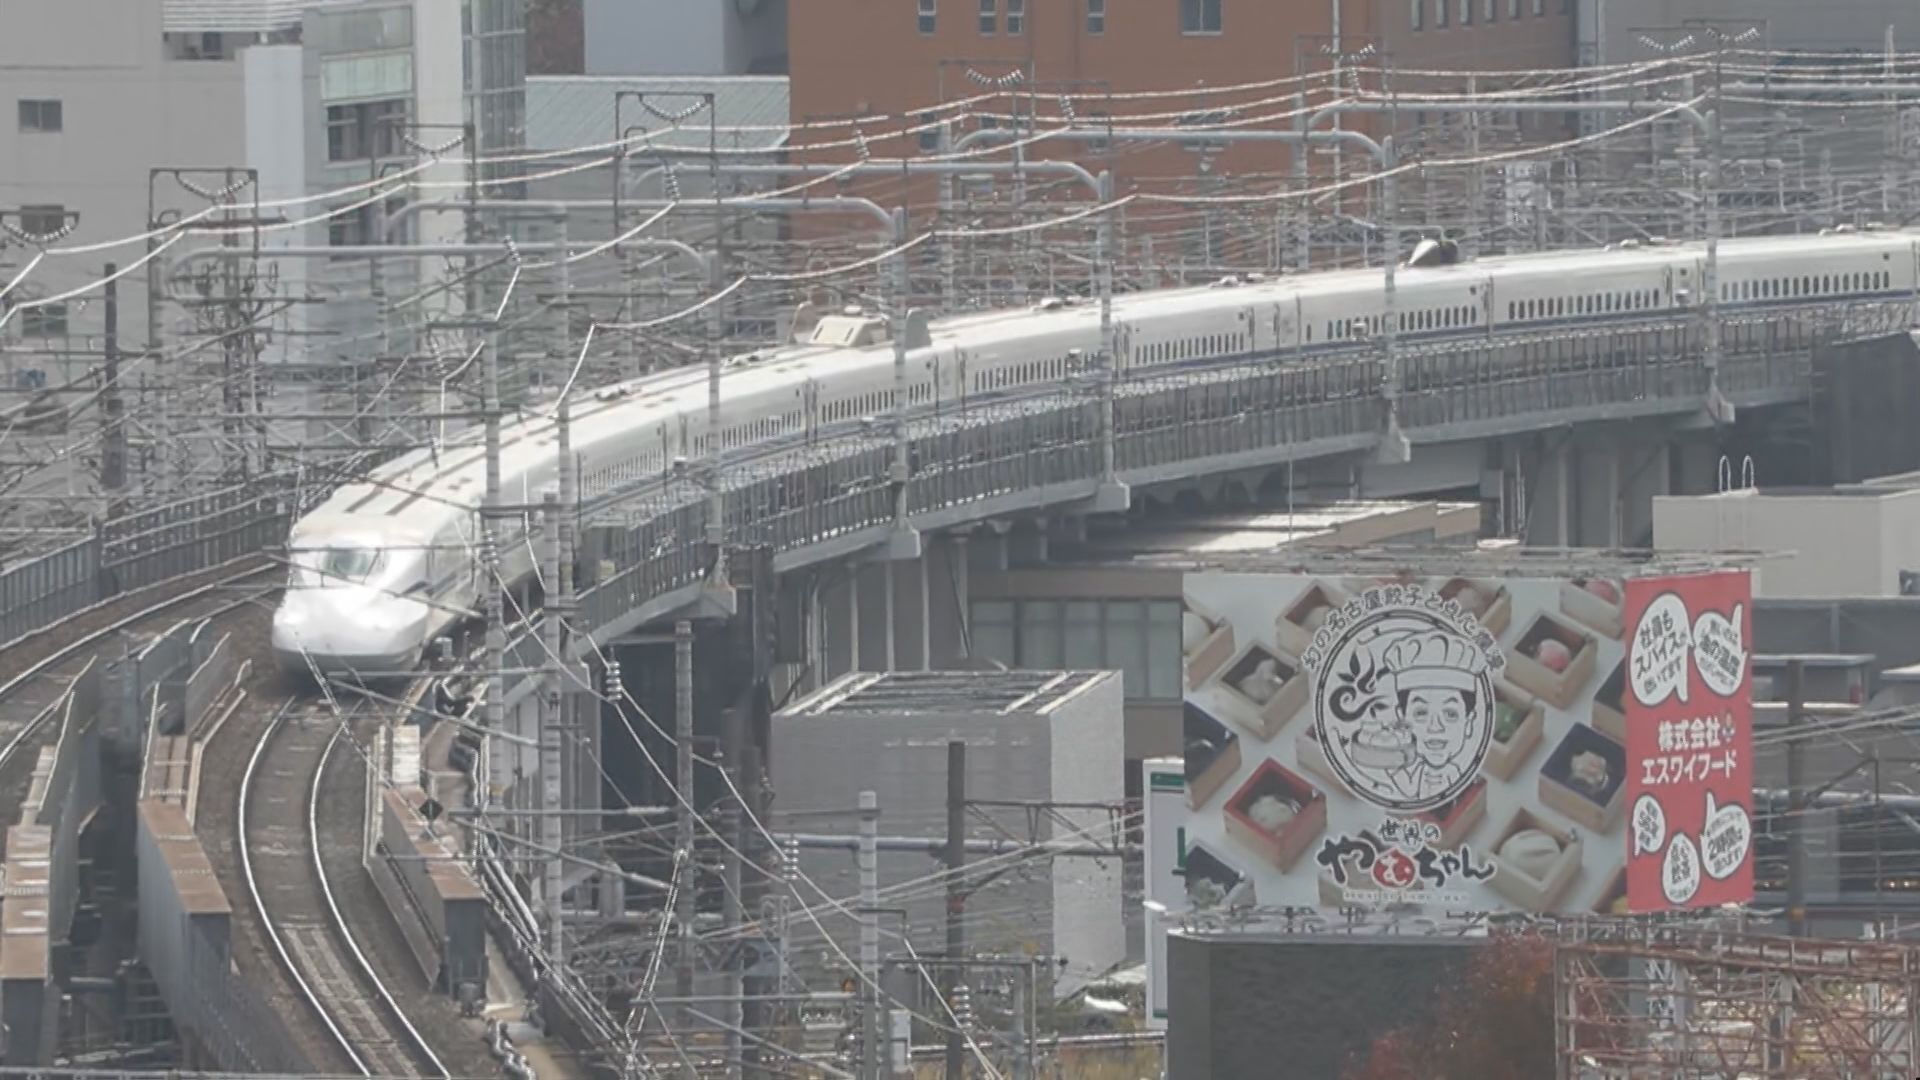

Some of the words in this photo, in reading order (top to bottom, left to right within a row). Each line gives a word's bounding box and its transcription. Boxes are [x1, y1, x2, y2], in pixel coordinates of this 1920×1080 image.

[1659, 717, 1721, 752] 株式会社
[1641, 750, 1737, 785] エスワイフード
[1378, 818, 1440, 846] 世界の
[1316, 838, 1495, 889] やむちゃん
